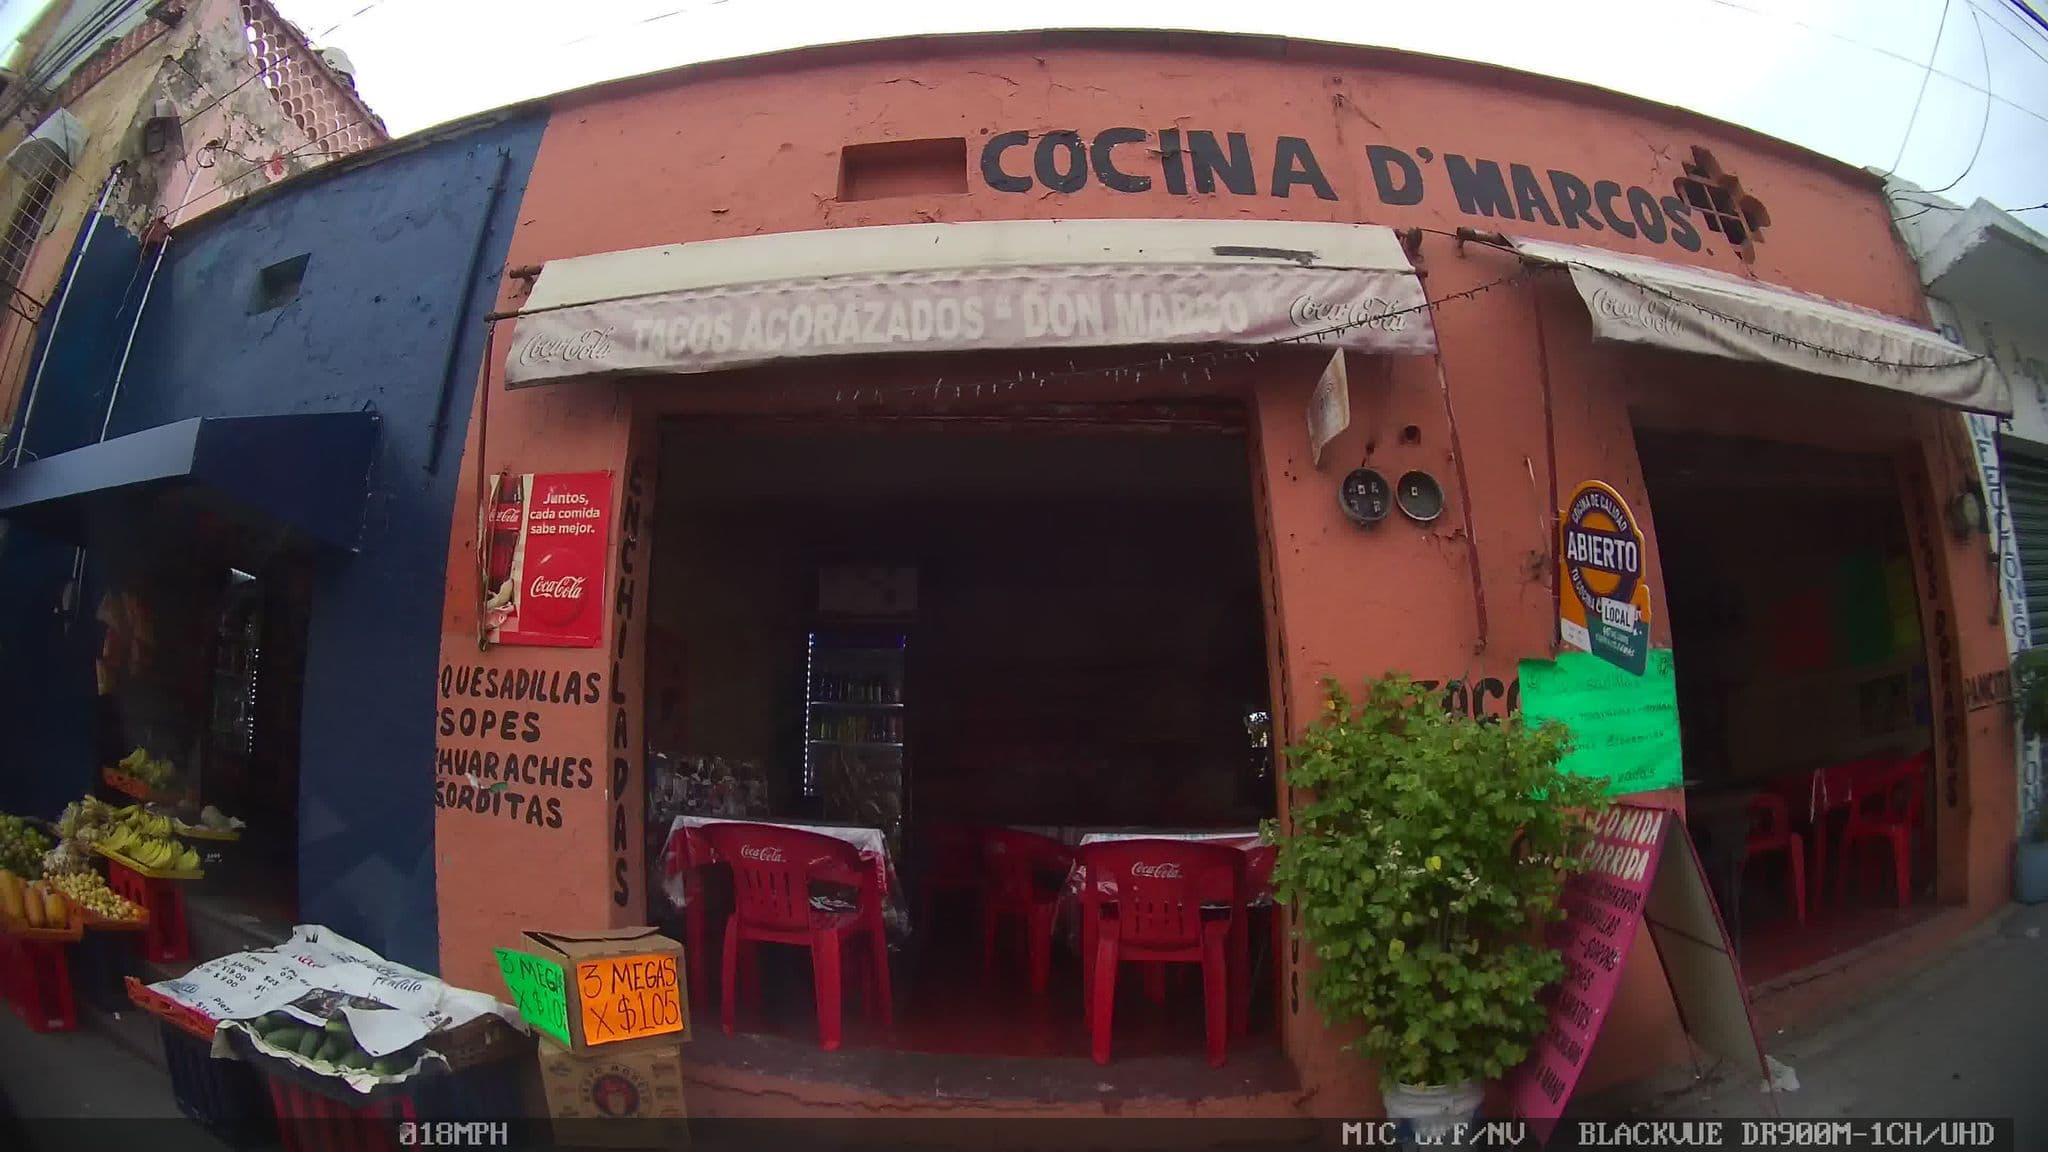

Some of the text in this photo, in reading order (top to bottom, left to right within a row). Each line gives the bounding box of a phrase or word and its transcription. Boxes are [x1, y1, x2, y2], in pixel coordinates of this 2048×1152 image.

[980, 126, 1338, 202] COCINA
[630, 309, 734, 359] TACOS
[737, 296, 984, 351] ACORAZADOS
[529, 507, 600, 520] cada comida
[542, 492, 589, 506] Juntos,
[529, 522, 596, 537] sabe mejor.
[1566, 531, 1638, 573] ABIERTO
[1603, 607, 1632, 628] LOCAL
[439, 663, 602, 706] QUESADILLAS
[439, 706, 542, 744] SOPES
[438, 747, 594, 790] HUARACHES
[495, 949, 514, 975] 3
[580, 957, 677, 999] 3 MEGAS
[532, 984, 567, 1031] $10
[617, 988, 679, 1034] $105
